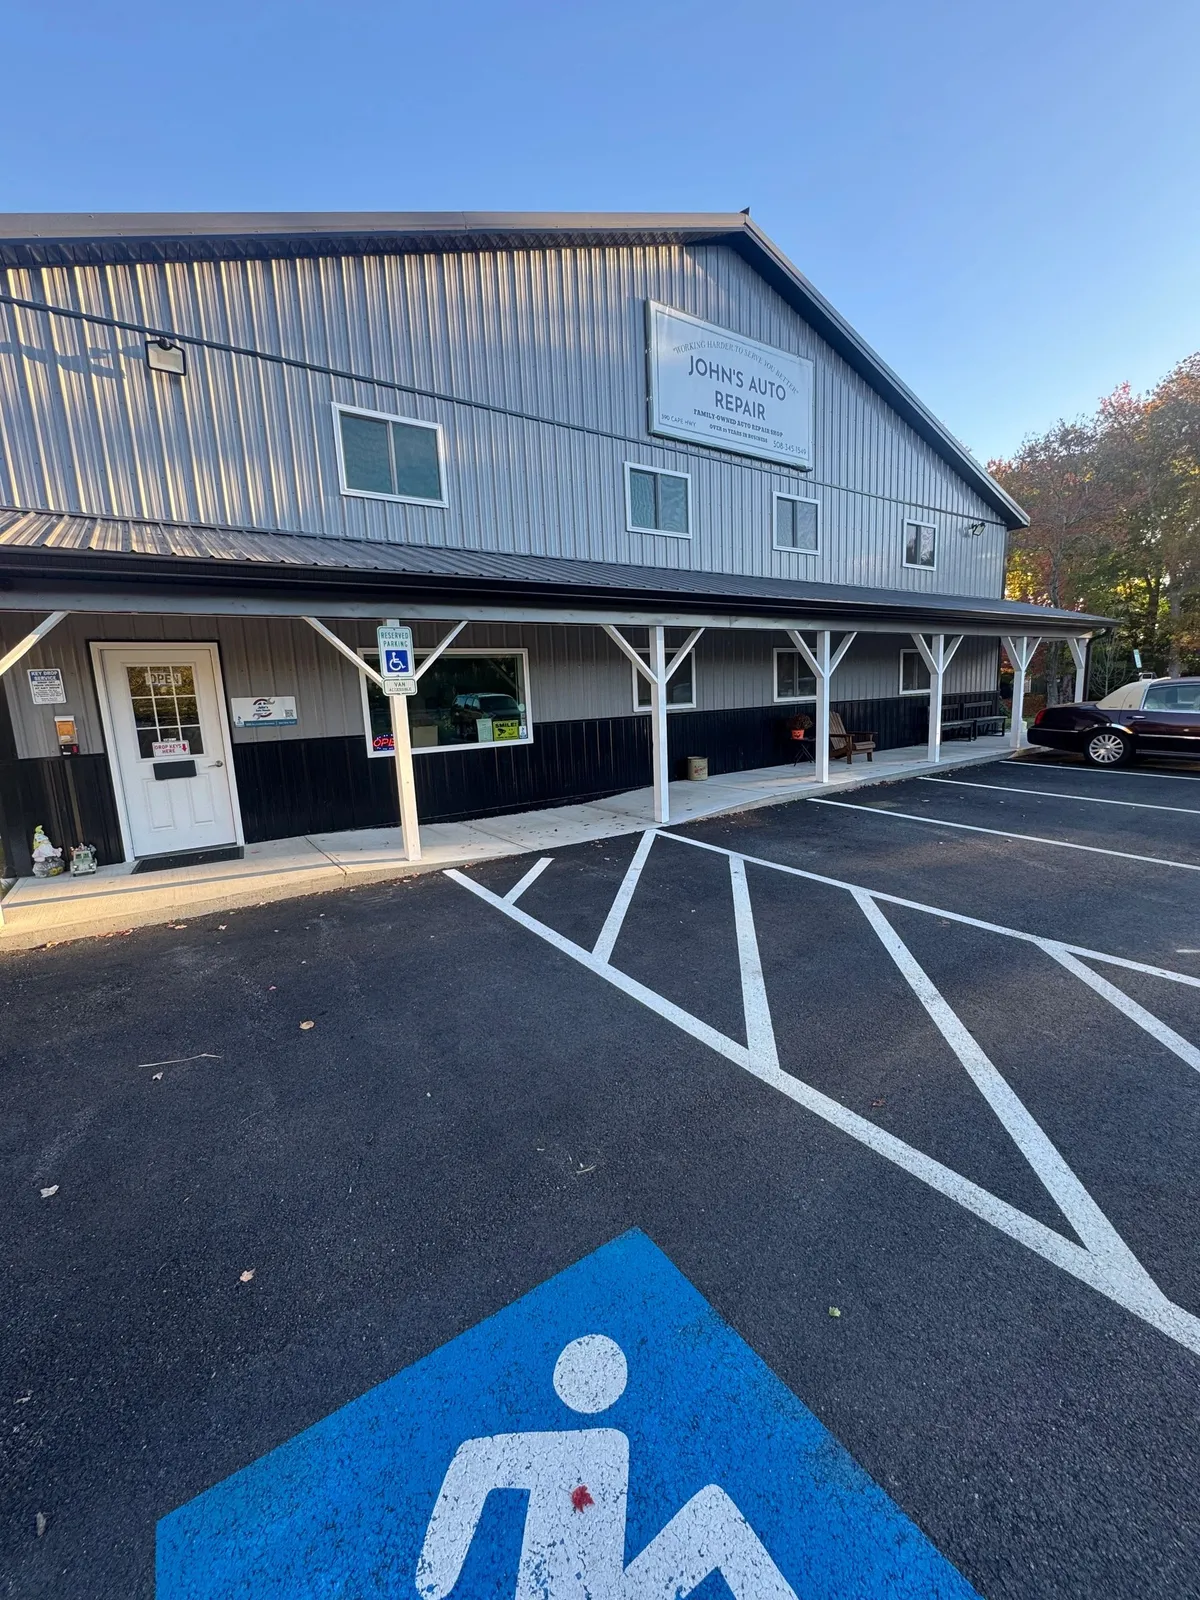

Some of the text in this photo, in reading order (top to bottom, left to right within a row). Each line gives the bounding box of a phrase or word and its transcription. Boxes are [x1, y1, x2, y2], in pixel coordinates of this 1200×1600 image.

[707, 340, 733, 351] HARDER
[734, 345, 743, 354] TO
[743, 348, 762, 364] SERVE
[763, 360, 775, 373] YOU
[688, 355, 786, 401] JOHN'S AUTO
[715, 390, 766, 421] REPAIR
[671, 415, 684, 424] CAPE
[693, 408, 783, 437] FAMILY-OWNED AUTO REPAIR SHOP
[709, 424, 722, 432] OVER
[728, 428, 742, 437] YEARS
[748, 433, 768, 443] BUSINESS
[381, 631, 408, 640] RESERVED
[148, 673, 180, 684] OPEN
[373, 738, 394, 747] OPE
